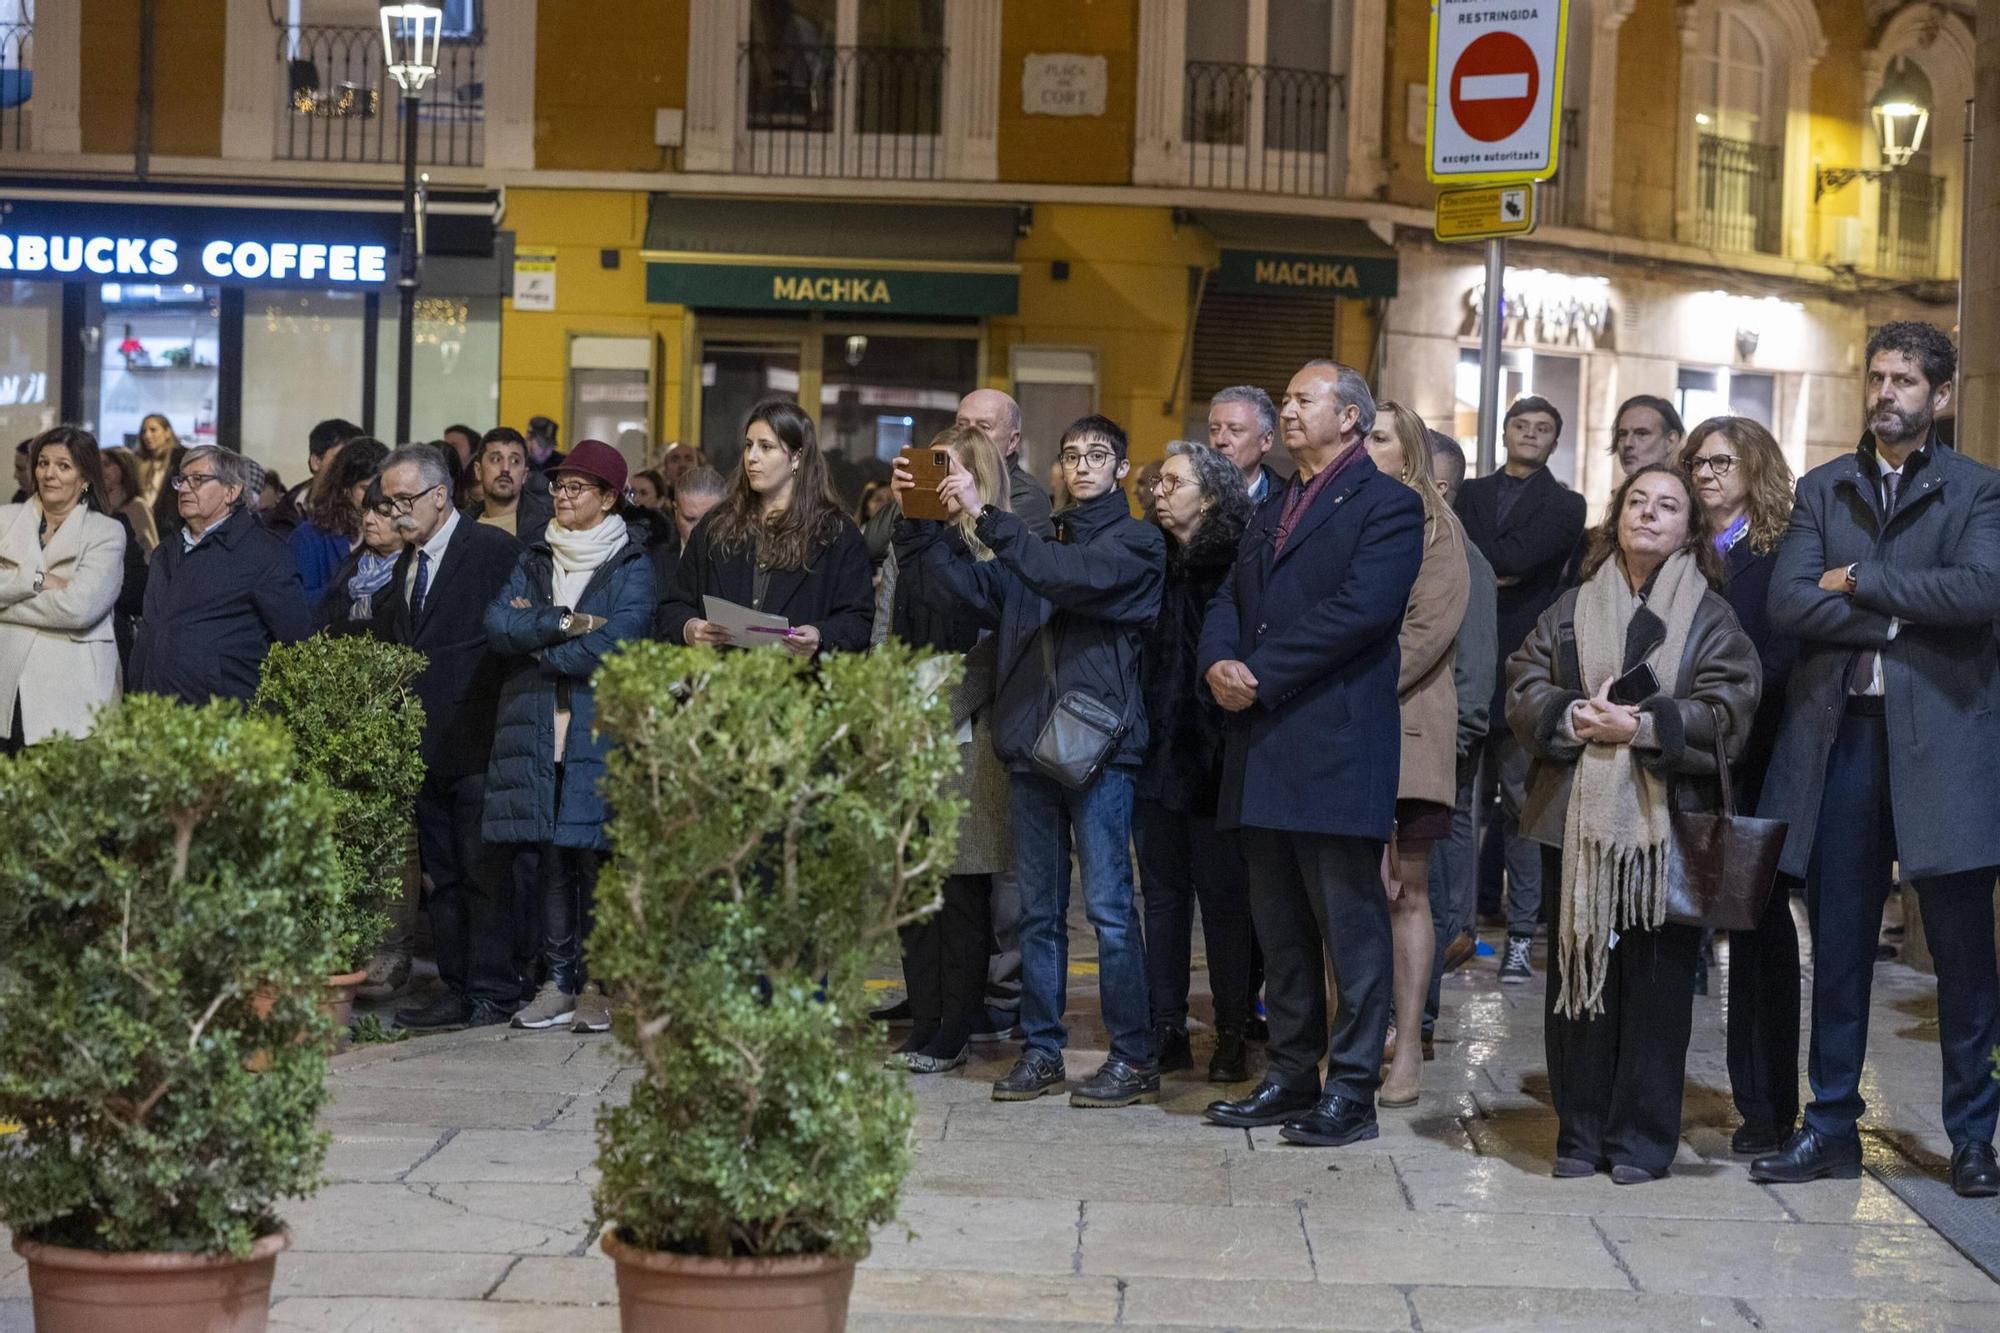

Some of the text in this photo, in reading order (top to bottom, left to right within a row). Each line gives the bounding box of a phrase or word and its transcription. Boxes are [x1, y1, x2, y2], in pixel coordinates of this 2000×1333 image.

[1458, 8, 1539, 24] RESTRINGIDA
[1041, 89, 1087, 105] CORT
[1442, 153, 1481, 165] excepte
[202, 240, 386, 282] COFFEE
[1255, 259, 1359, 288] MACHKA
[773, 276, 891, 304] MACHKA
